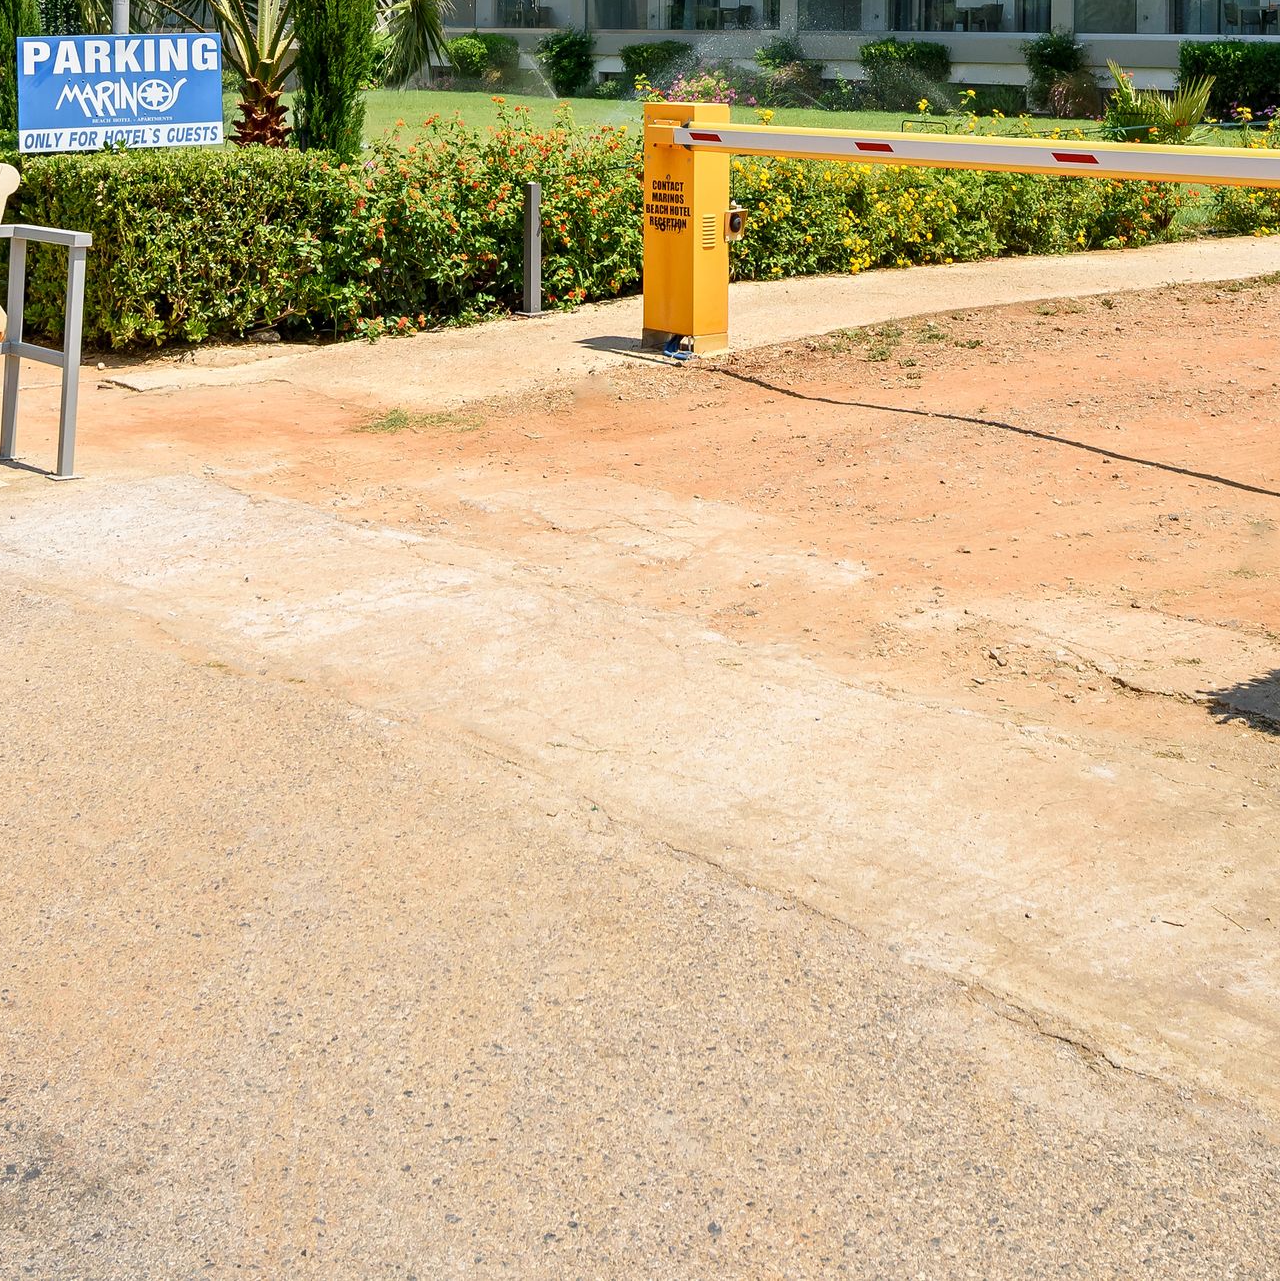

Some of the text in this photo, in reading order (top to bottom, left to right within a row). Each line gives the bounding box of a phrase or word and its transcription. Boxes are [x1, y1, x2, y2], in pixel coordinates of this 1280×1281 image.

[23, 37, 218, 76] PARKING
[55, 77, 188, 118] MARINOS
[24, 132, 63, 150] ONLY
[68, 130, 98, 148] FOR
[166, 125, 218, 143] GUESTS
[652, 180, 684, 192] CONTACT
[652, 192, 684, 204] MARINOS
[646, 204, 691, 217] BEACH HOTEL
[649, 216, 687, 229] RECEPTION
